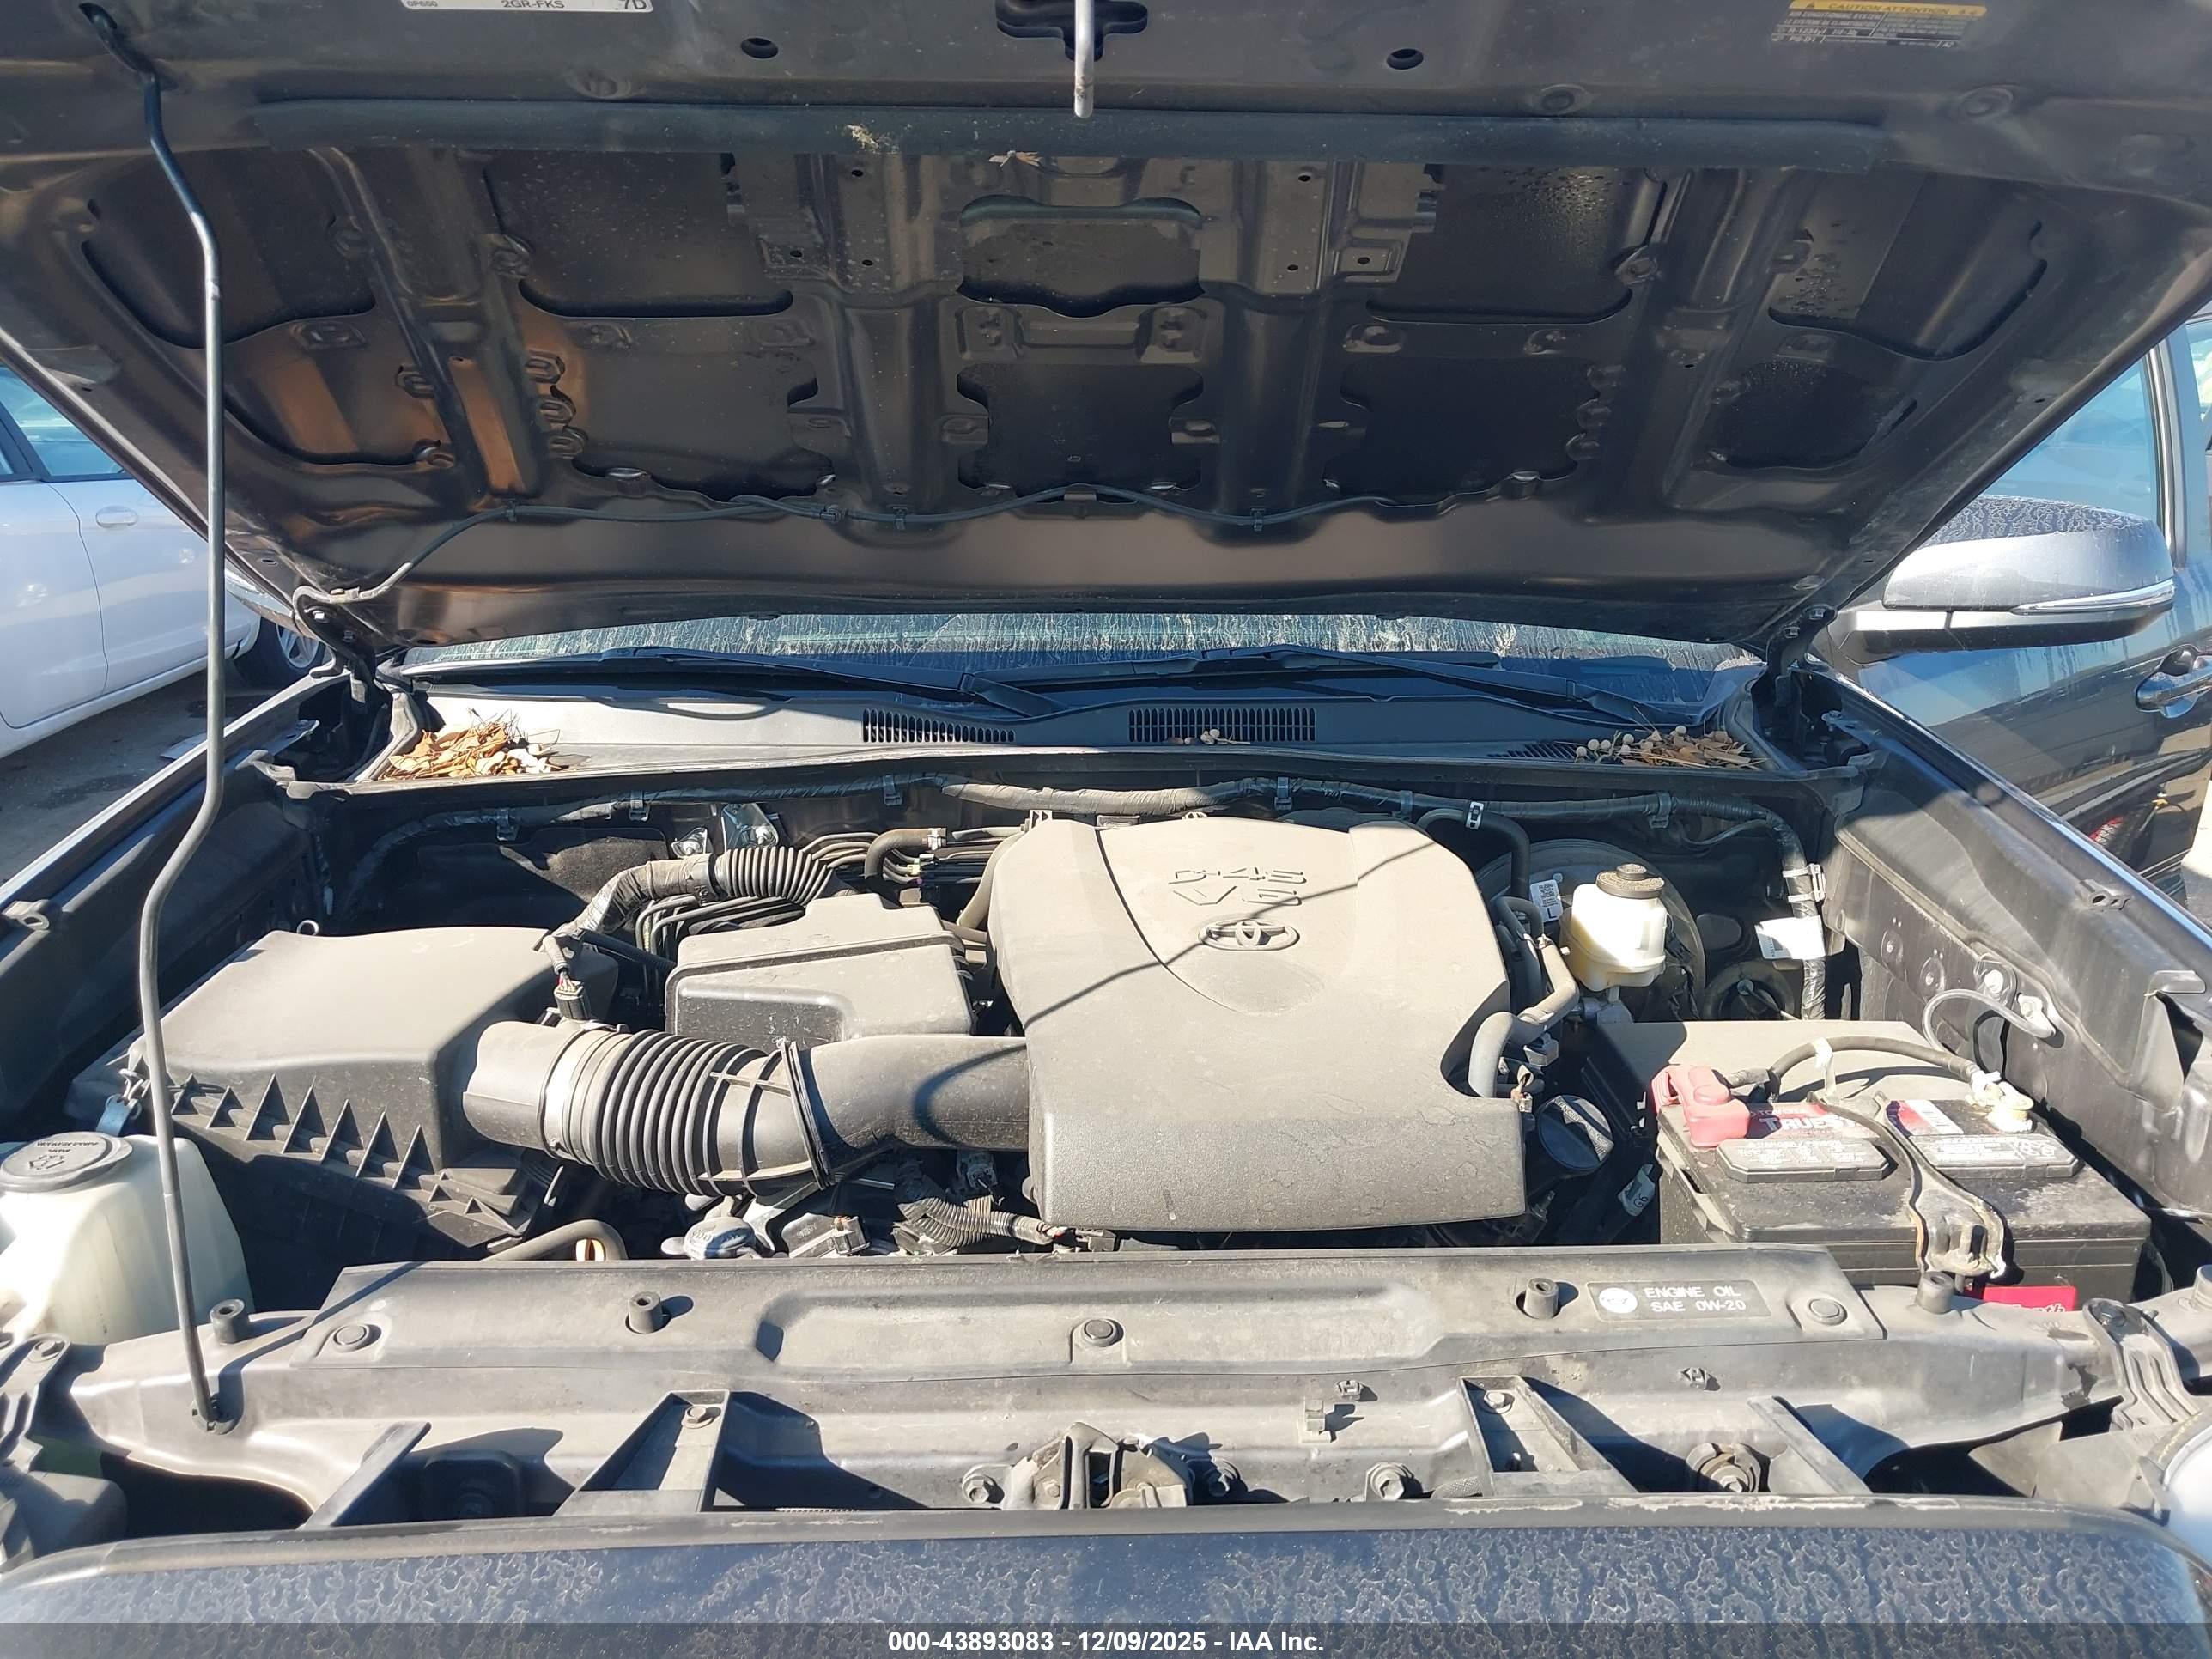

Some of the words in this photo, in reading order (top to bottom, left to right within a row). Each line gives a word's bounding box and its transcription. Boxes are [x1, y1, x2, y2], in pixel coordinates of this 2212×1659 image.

[501, 0, 565, 9] 2GR-FKS
[1829, 3, 1882, 11] CAUTION
[1883, 5, 1950, 14] ATTENTION
[1547, 908, 1558, 919] L
[1644, 1286, 1705, 1299] ENGINE
[1713, 1286, 1741, 1298] OIL
[1651, 1300, 1686, 1313] SAE
[1696, 1299, 1747, 1312] 0W-20
